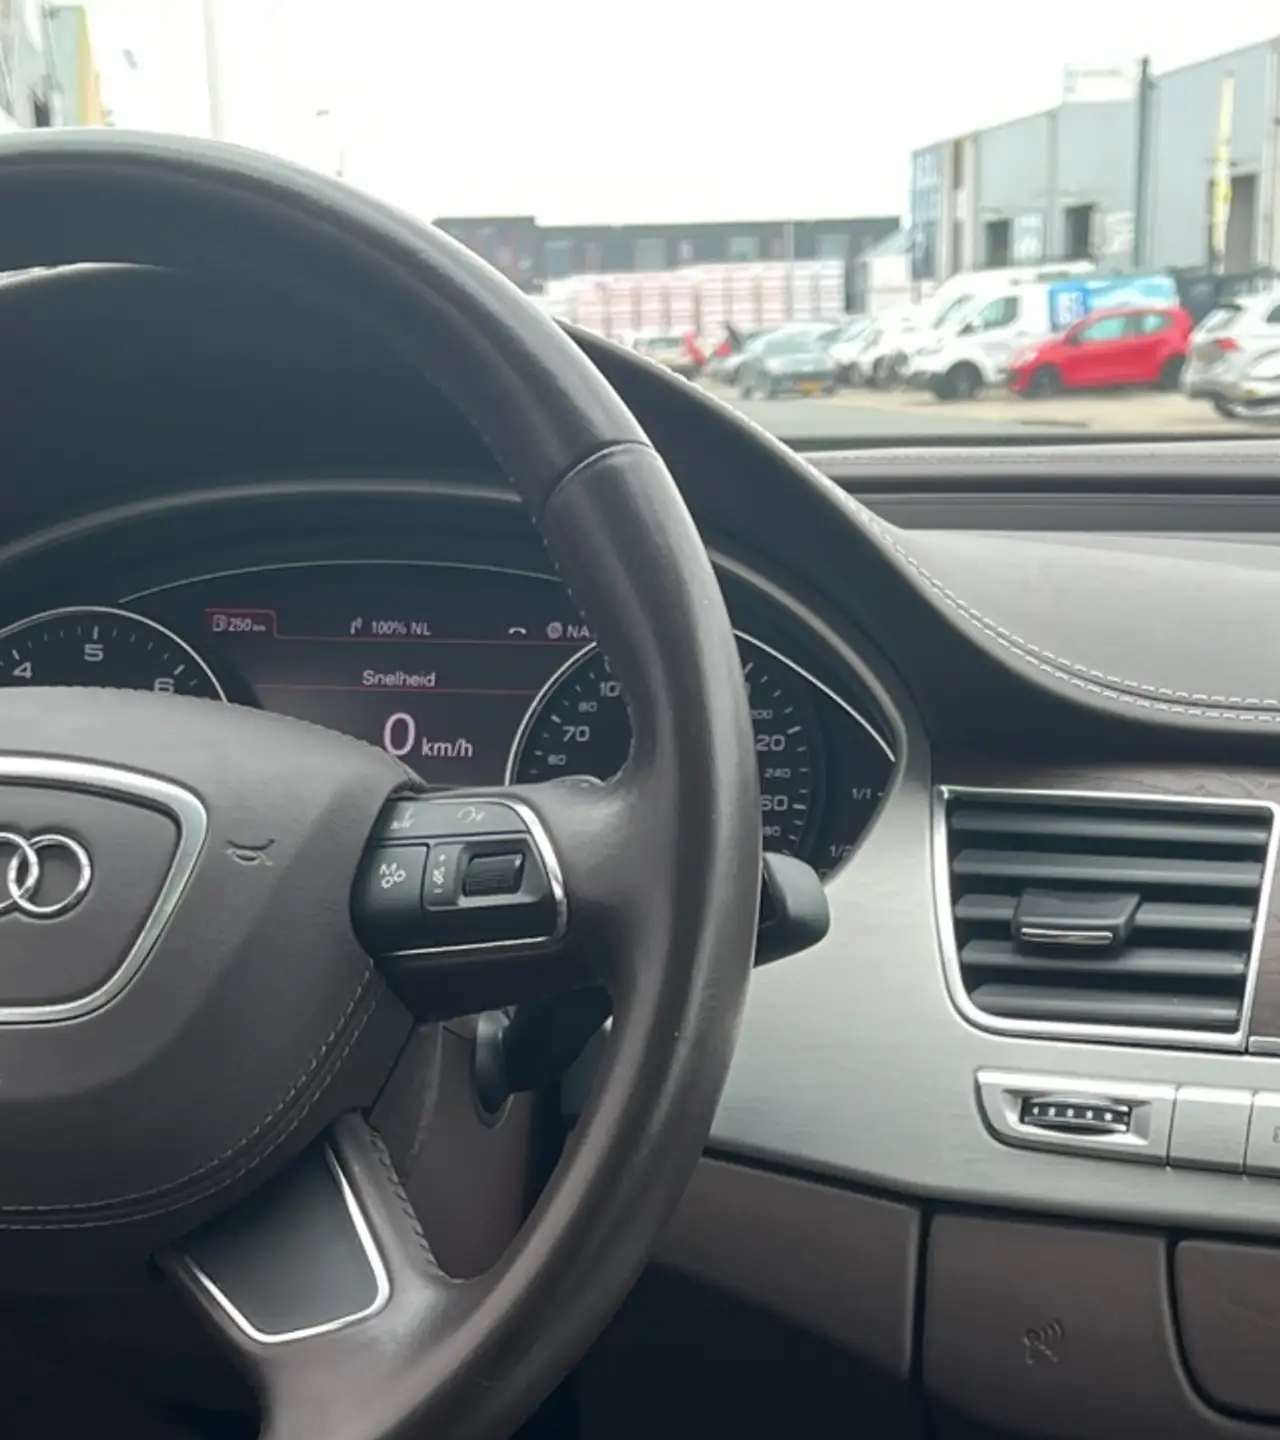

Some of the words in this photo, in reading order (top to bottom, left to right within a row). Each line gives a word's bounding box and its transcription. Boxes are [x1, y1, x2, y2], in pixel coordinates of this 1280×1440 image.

[370, 620, 408, 636] 100%
[410, 622, 432, 636] NL
[84, 645, 104, 661] 5
[13, 662, 32, 678] 4
[362, 669, 437, 688] Snelheid
[383, 712, 416, 757] 0
[421, 738, 473, 758] km/h
[562, 725, 590, 742] 70
